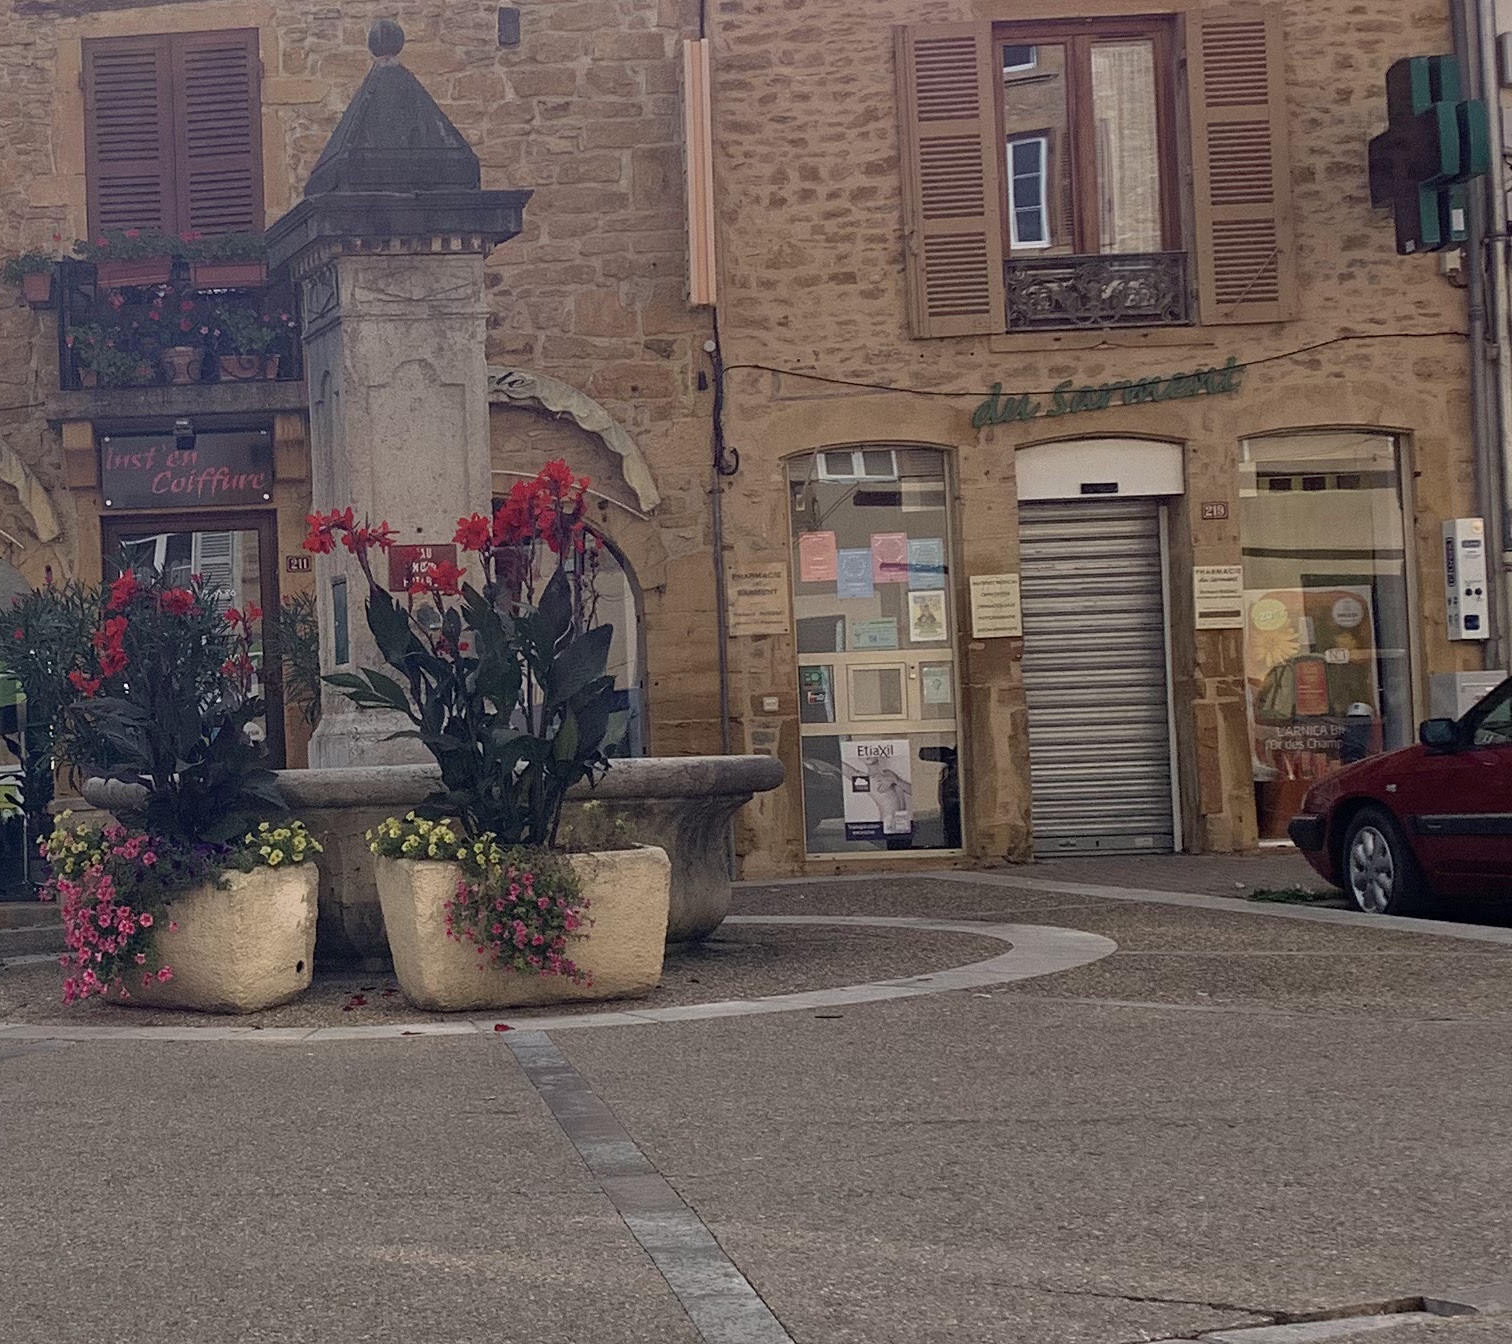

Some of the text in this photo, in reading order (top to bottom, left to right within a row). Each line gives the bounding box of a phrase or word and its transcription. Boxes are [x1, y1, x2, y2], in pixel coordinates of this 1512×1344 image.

[972, 355, 1246, 429] du Sarment
[151, 466, 265, 499] Coiffure
[1205, 505, 1225, 517] 219
[290, 558, 308, 570] 211
[1285, 739, 1305, 750] des
[1307, 738, 1343, 751] Champ
